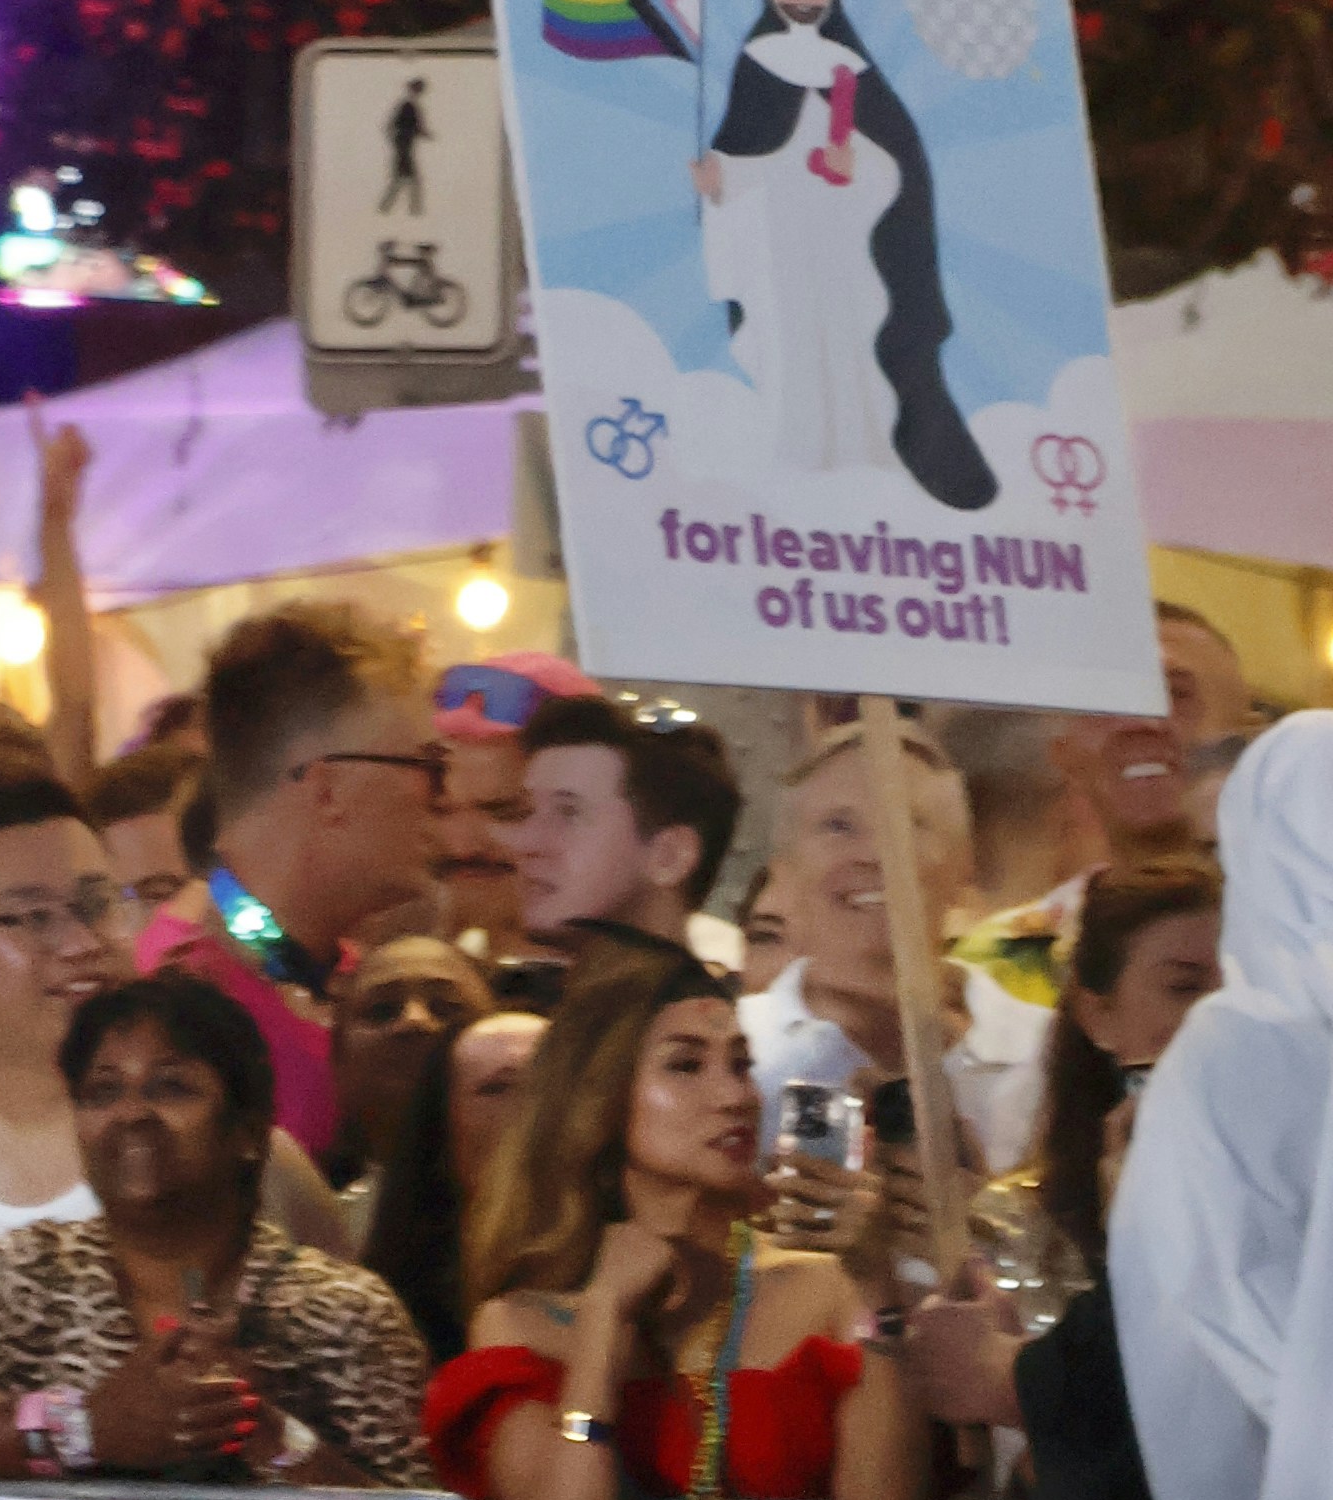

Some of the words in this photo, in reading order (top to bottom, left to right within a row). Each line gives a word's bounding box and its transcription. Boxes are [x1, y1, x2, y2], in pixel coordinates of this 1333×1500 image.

[659, 507, 742, 564] for
[750, 513, 966, 595] leaving
[971, 534, 1087, 594] NUN
[756, 577, 815, 629] of
[823, 590, 888, 635] us
[895, 592, 1011, 646] out!
